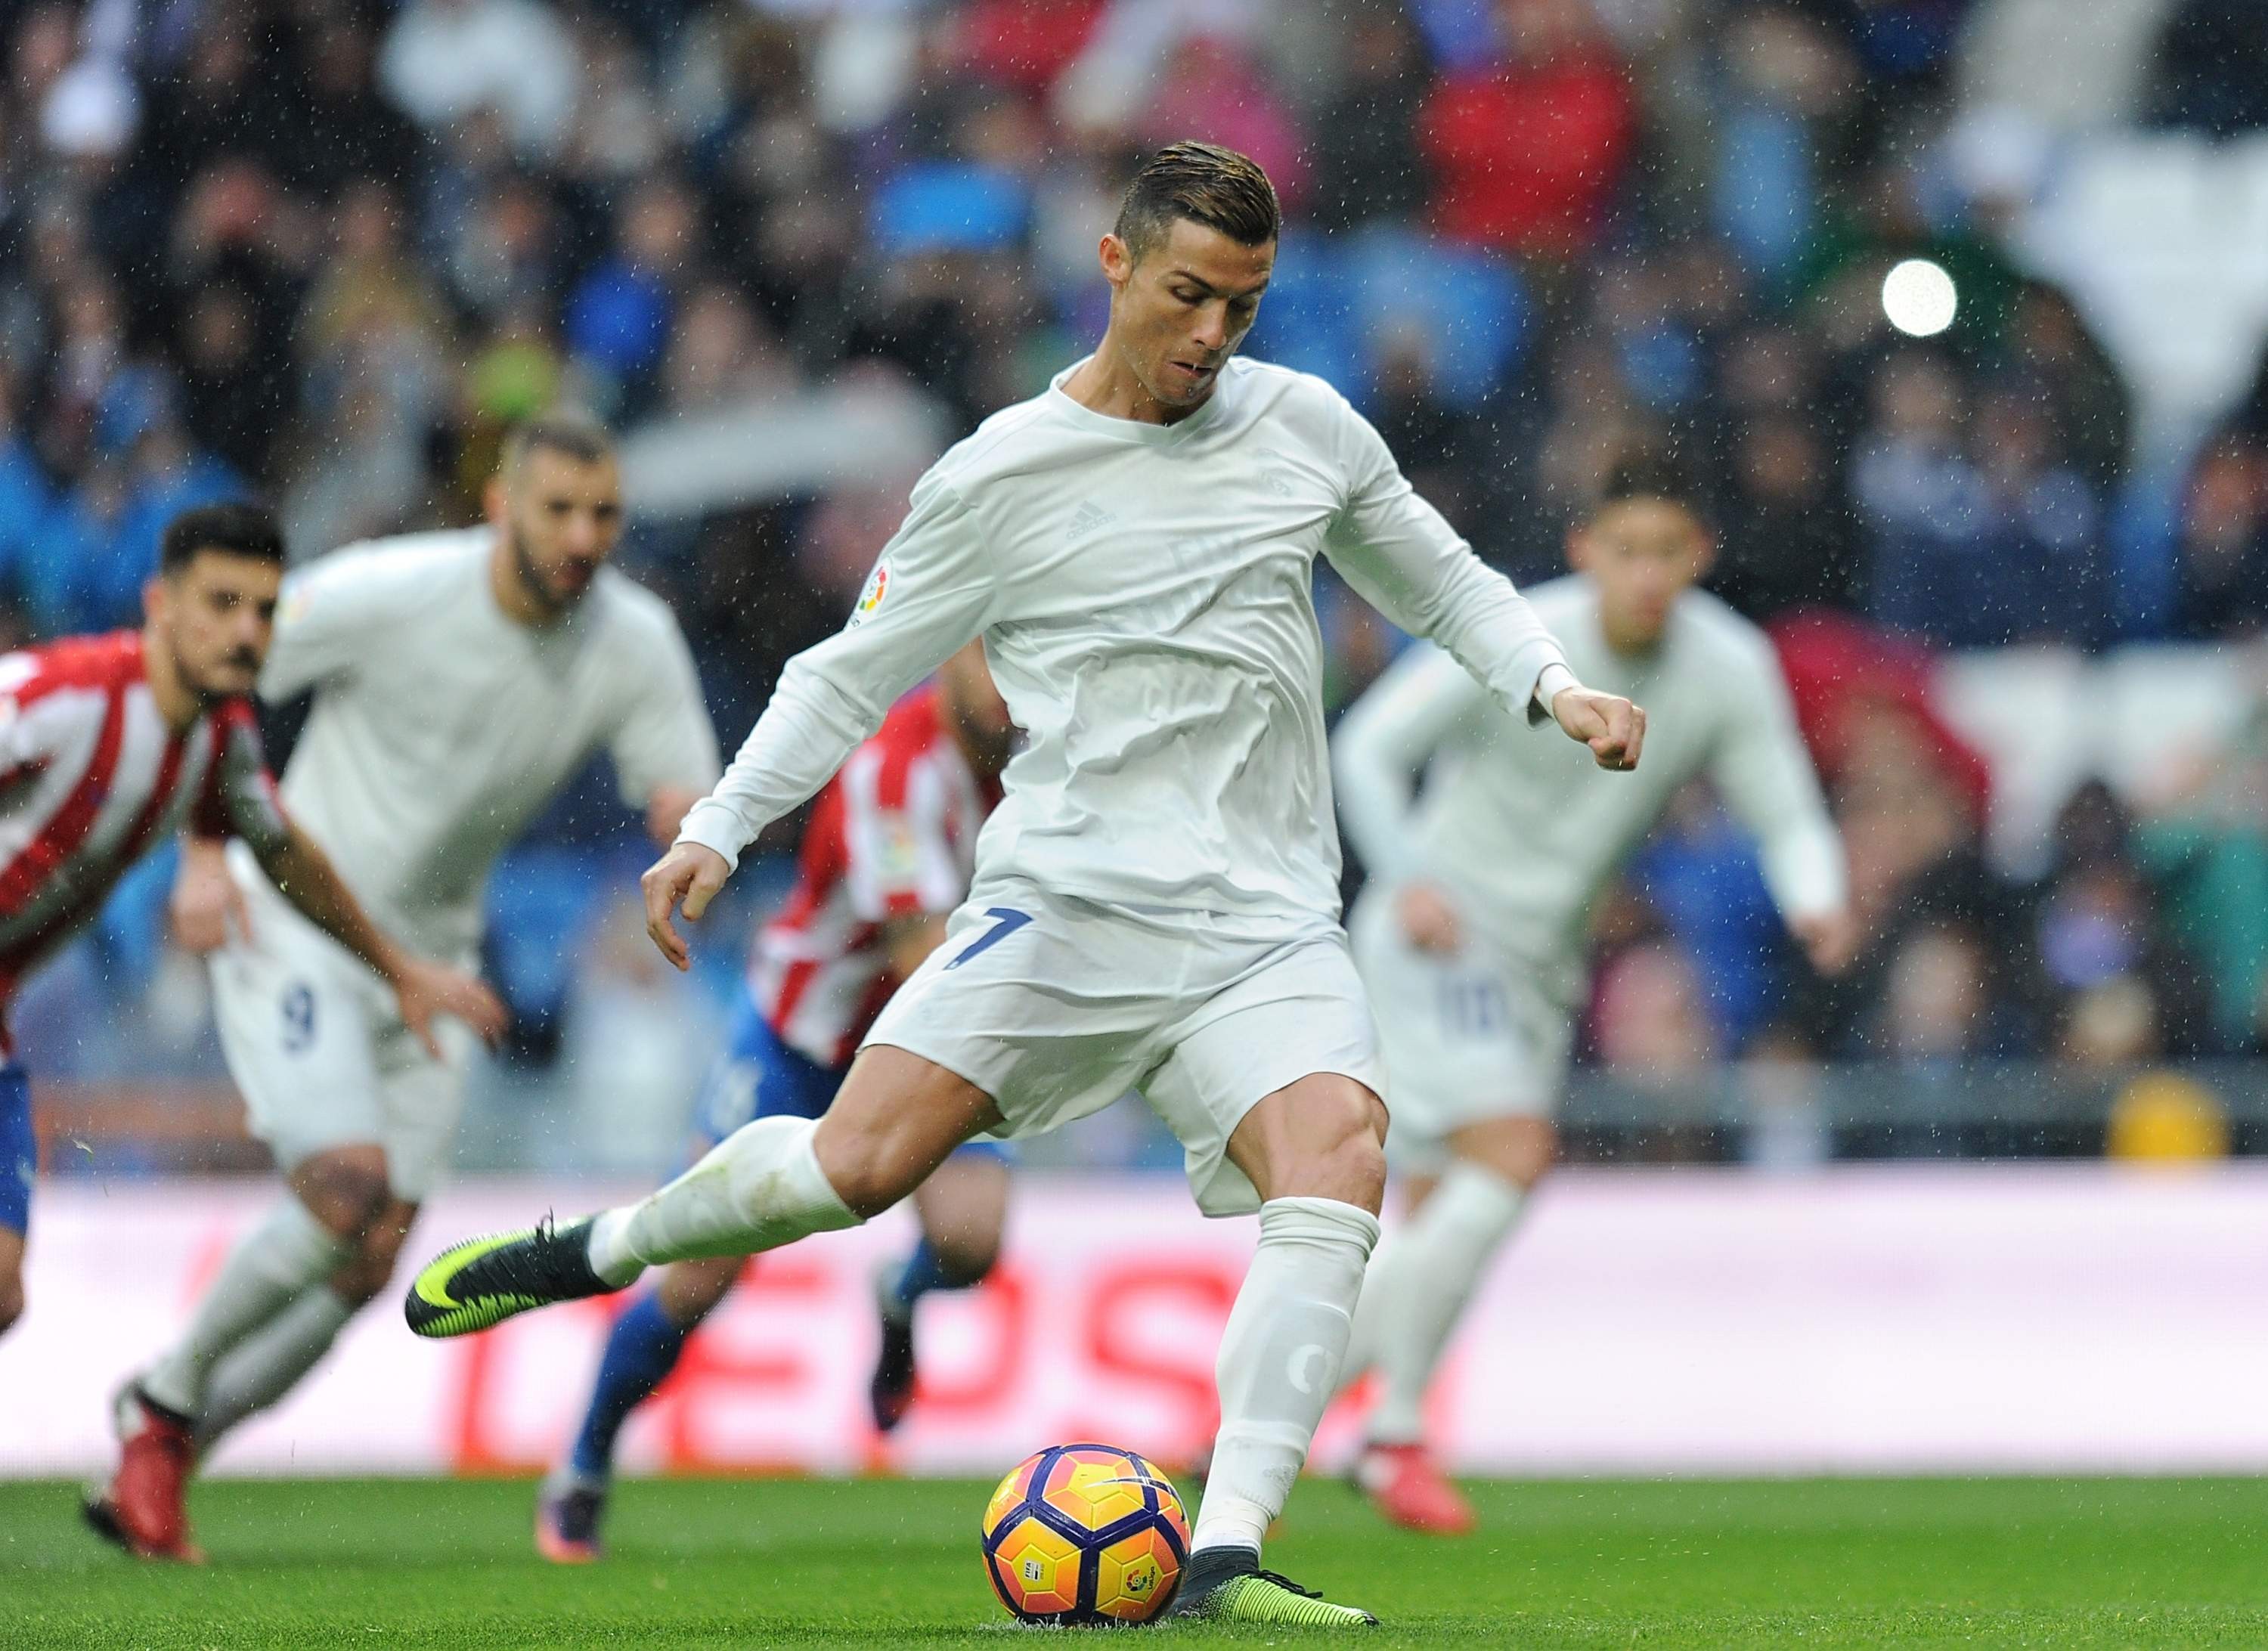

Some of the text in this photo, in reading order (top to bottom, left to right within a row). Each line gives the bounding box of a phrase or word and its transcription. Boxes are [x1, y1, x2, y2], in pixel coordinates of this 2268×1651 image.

[1065, 512, 1117, 541] adidas
[942, 907, 1034, 970] 7
[280, 982, 318, 1055] 9
